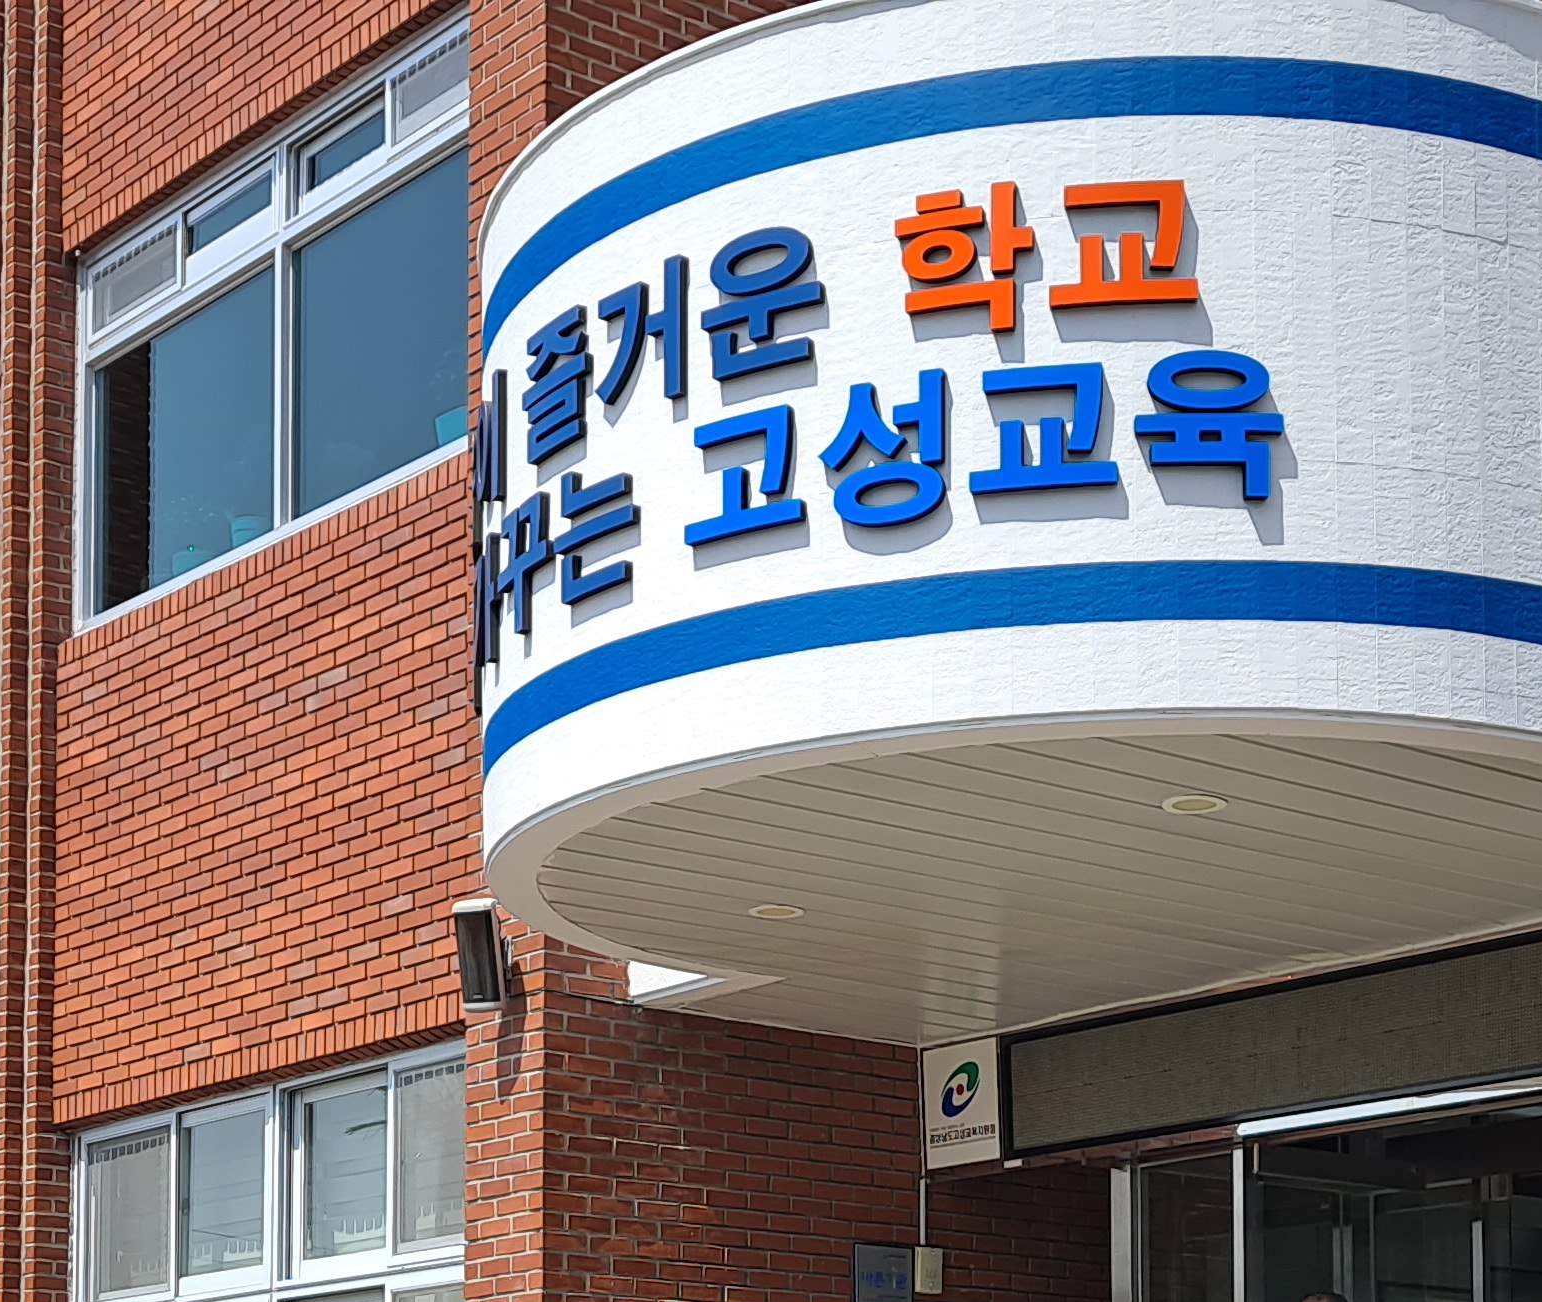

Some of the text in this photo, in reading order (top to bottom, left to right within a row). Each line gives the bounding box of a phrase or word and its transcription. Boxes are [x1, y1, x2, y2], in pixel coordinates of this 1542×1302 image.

[522, 226, 827, 468] 즐거운
[894, 179, 1199, 334] 학교
[684, 349, 1285, 548] 고성교육
